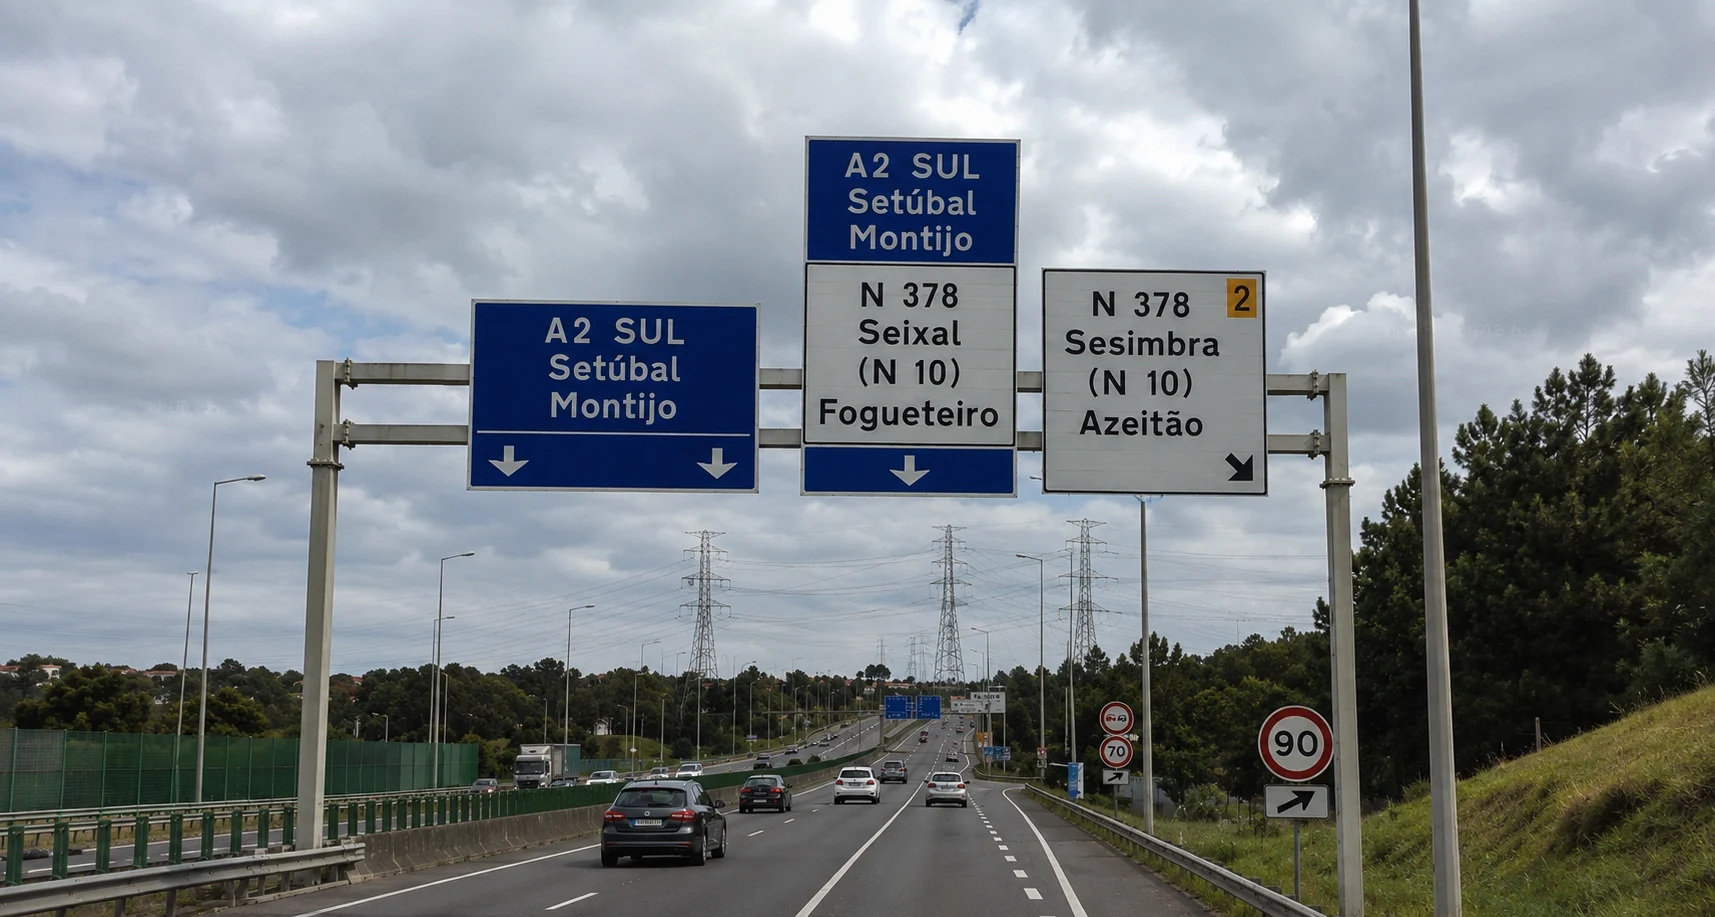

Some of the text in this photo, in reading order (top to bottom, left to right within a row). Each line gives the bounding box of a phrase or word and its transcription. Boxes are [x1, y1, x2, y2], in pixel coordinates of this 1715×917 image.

[844, 152, 980, 180] A2 SUL
[847, 187, 977, 216] Setúbal
[849, 224, 973, 257] Montijo
[861, 281, 959, 309] N 378
[1092, 290, 1190, 318] N 378
[1233, 285, 1250, 312] 2
[544, 317, 685, 345] A2 SUL
[858, 318, 962, 346] Seixal
[1064, 329, 1220, 358] Sesimbra
[548, 353, 681, 382] Setúbal
[858, 356, 960, 389] (N 10)
[1088, 367, 1193, 399] (N 10)
[550, 391, 677, 425] Montijo
[819, 398, 999, 432] Fogueteiro
[1079, 409, 1203, 437] Azeitão
[1107, 745, 1126, 758] 70
[1274, 730, 1319, 757] 90
